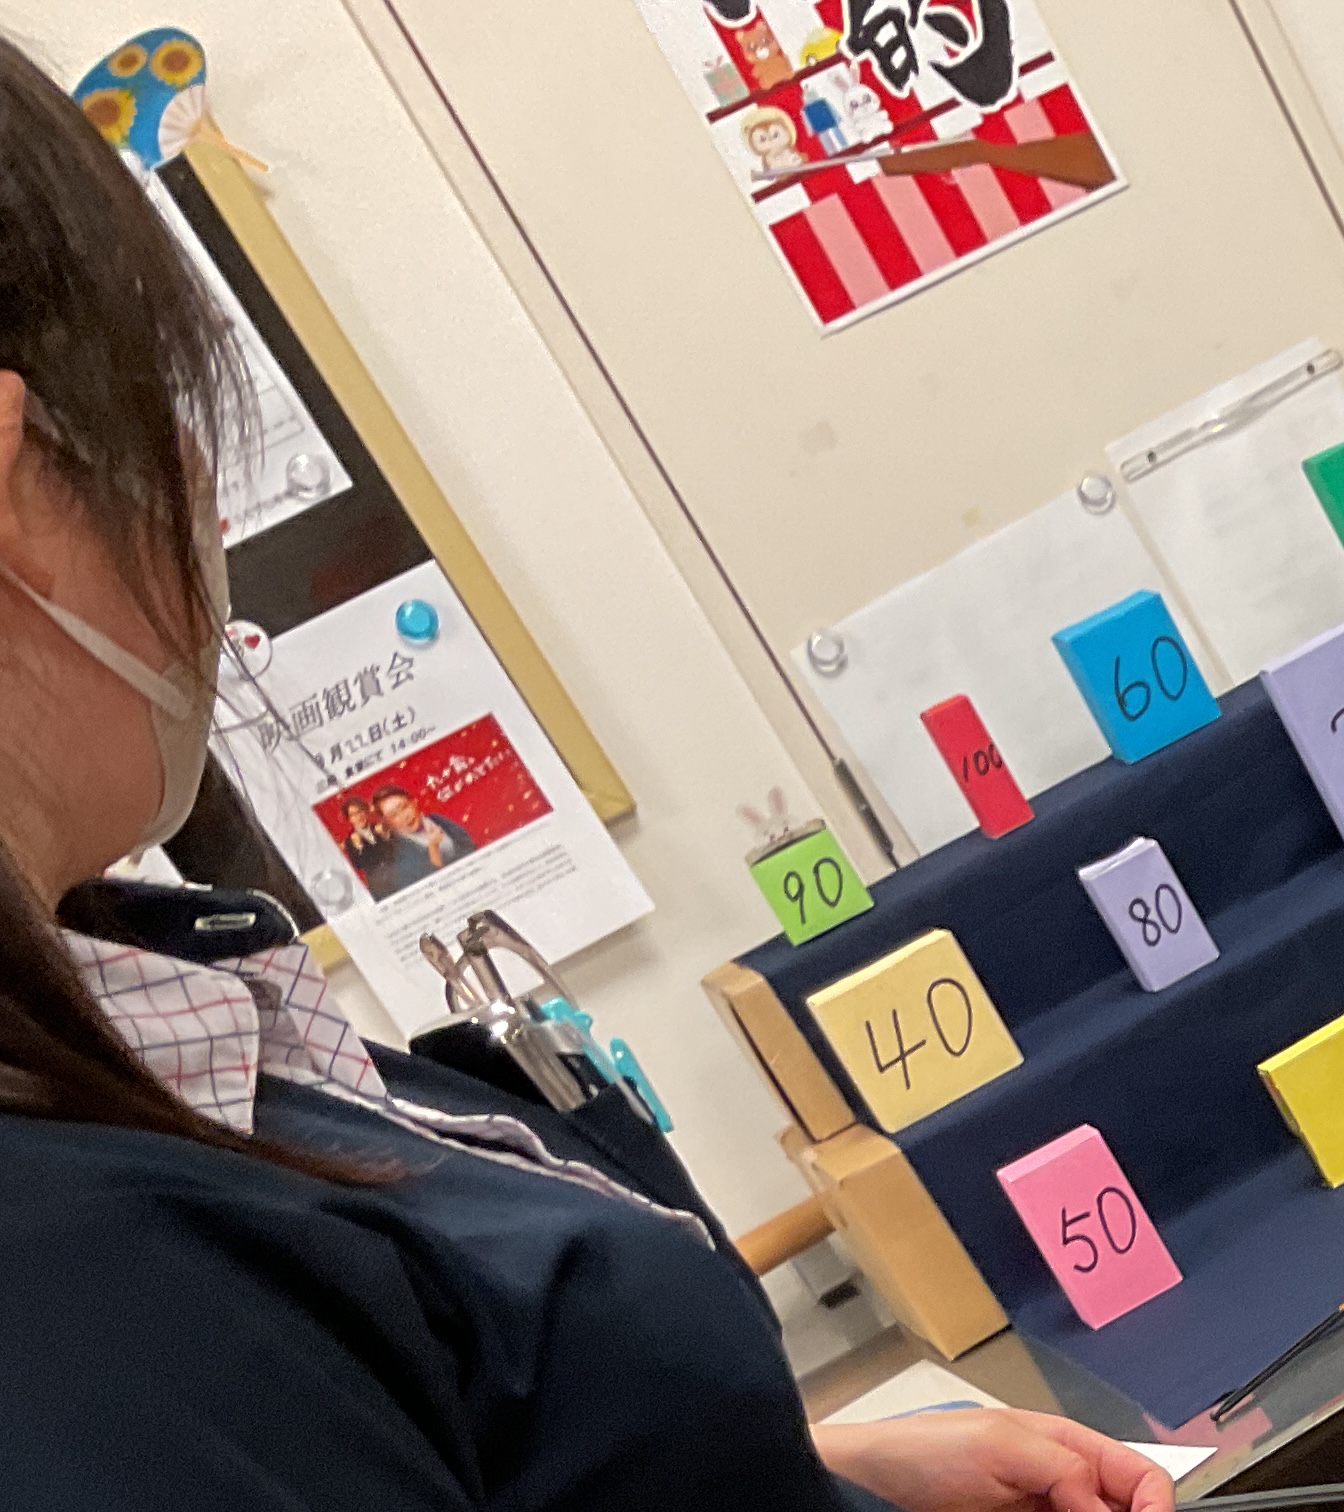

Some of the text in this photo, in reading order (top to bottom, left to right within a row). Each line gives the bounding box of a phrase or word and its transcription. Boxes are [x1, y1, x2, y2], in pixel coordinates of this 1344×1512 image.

[1113, 635, 1187, 722] 60
[962, 743, 1003, 781] 100
[783, 857, 843, 925] 90
[1128, 883, 1183, 947] 80
[865, 977, 973, 1090] 40
[1061, 1186, 1138, 1273] 50
